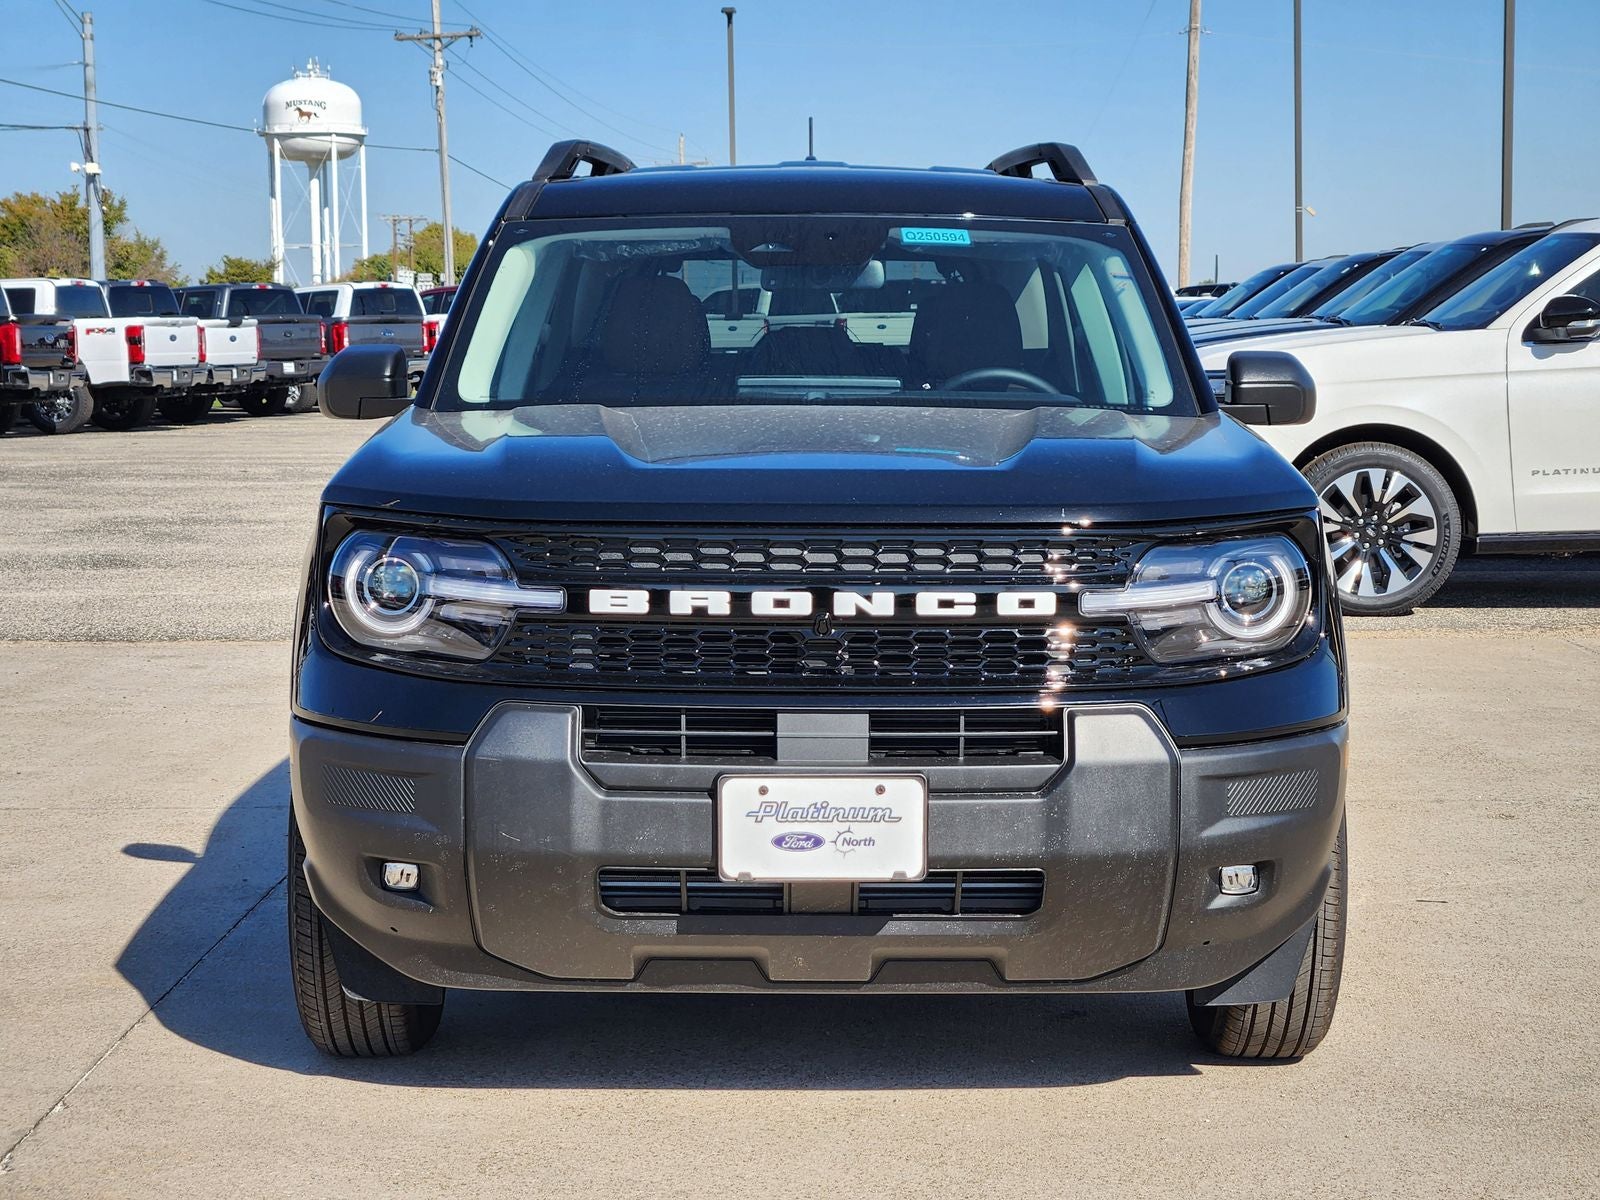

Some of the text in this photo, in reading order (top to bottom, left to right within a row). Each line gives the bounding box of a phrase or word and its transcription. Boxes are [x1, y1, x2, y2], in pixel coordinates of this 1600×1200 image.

[285, 99, 327, 110] MUSTANG
[905, 231, 966, 242] Q250594
[86, 327, 116, 335] FX4
[1432, 526, 1450, 576] MICHELIN
[588, 588, 1057, 617] BRONCO
[745, 800, 902, 823] Platinum
[781, 835, 815, 849] Ford
[842, 836, 876, 847] North
